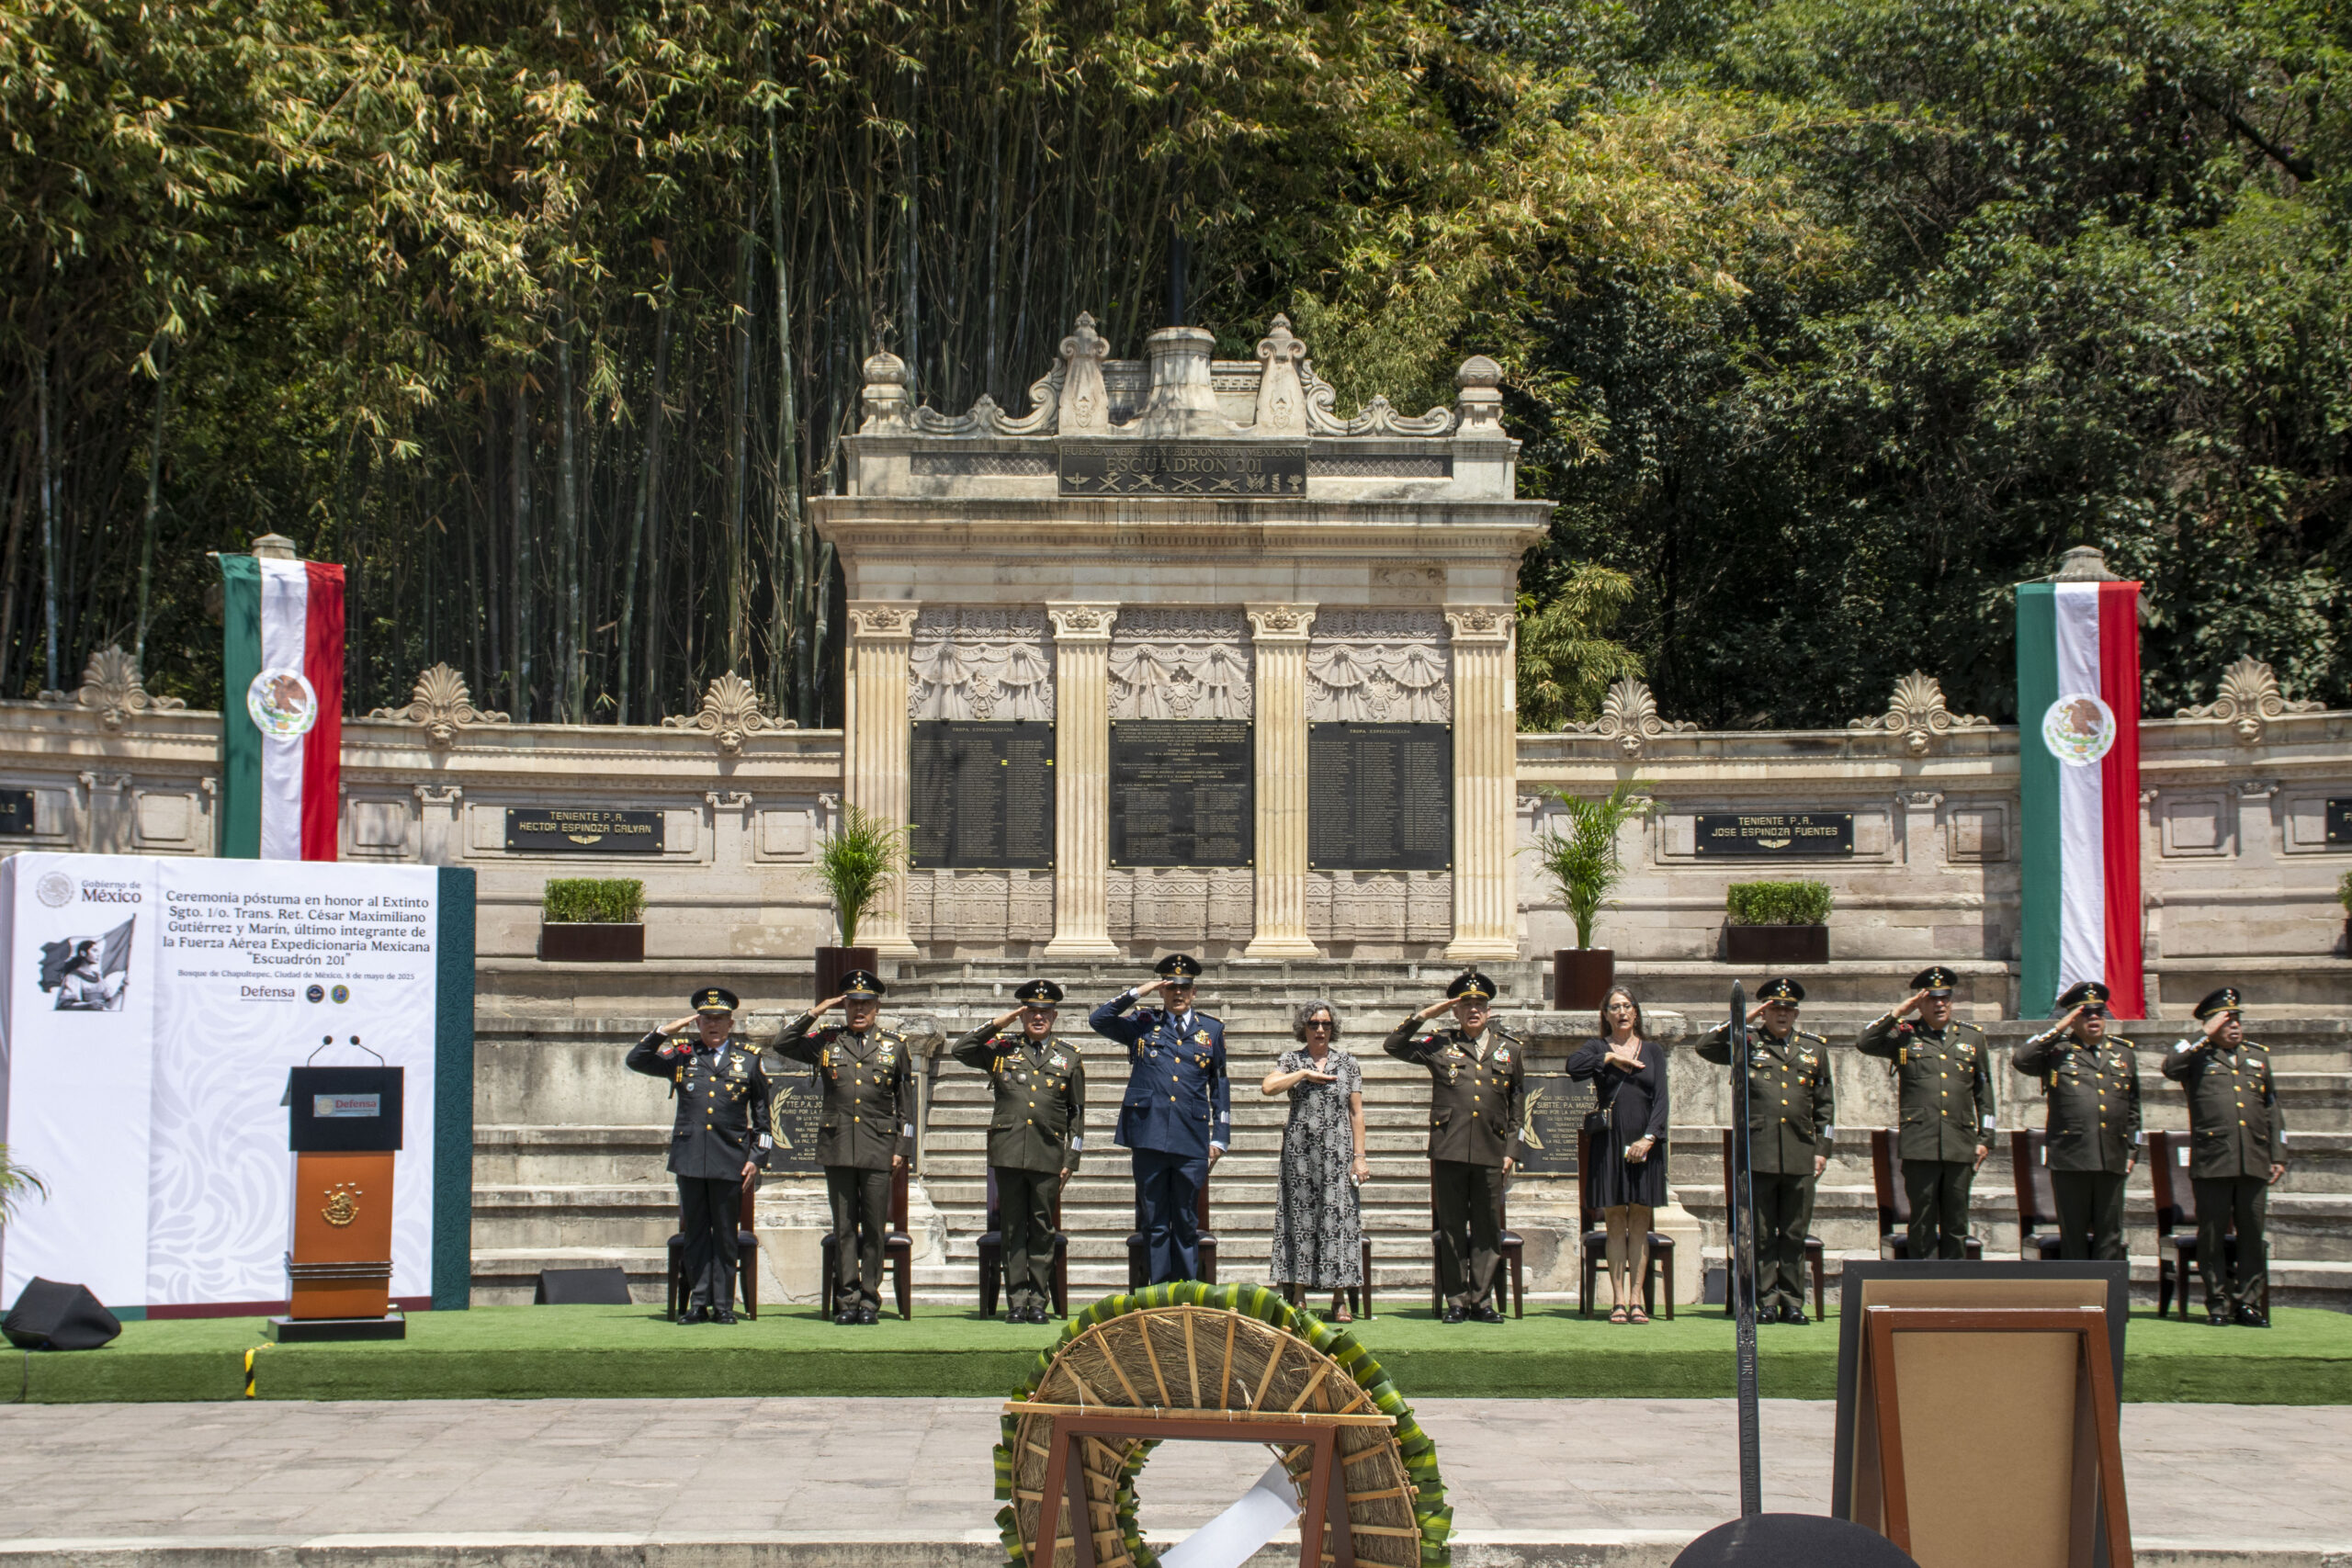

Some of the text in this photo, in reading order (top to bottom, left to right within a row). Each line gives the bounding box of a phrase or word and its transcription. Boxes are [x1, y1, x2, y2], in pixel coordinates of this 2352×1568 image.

[1064, 446, 1303, 457] FUERZA AEREA EXPEDICIONARIA MEXICANA
[1104, 457, 1263, 474] ESCUADRON 201
[550, 811, 627, 822] TENIENTE P.A.
[1737, 816, 1814, 826] TENIENTE P.A.
[519, 822, 651, 834] HECTOR ESPINOZA GALVAN
[1711, 827, 1838, 837] JOSE ESPINOZA FUENTES
[81, 880, 141, 889] Gobierno de
[81, 888, 141, 903] México
[165, 890, 429, 908] Ceremonia póstuma en honor al Extinto
[169, 906, 203, 920] Sgto.
[233, 908, 274, 919] Trans.
[277, 908, 304, 919] Ret.
[308, 909, 345, 921] César
[349, 910, 426, 923] Maximiliano
[168, 920, 426, 939] Gutiérrez y Marín, último integrante de
[163, 936, 430, 953] la Fuerza Aérea Expedicionaria Mexicana
[177, 969, 207, 978] Bosque
[220, 970, 272, 979] Chapultepec,
[314, 971, 344, 979] México,
[241, 985, 295, 998] Defensa
[334, 1099, 377, 1109] Defensa
[1741, 1354, 1753, 1375] POR
